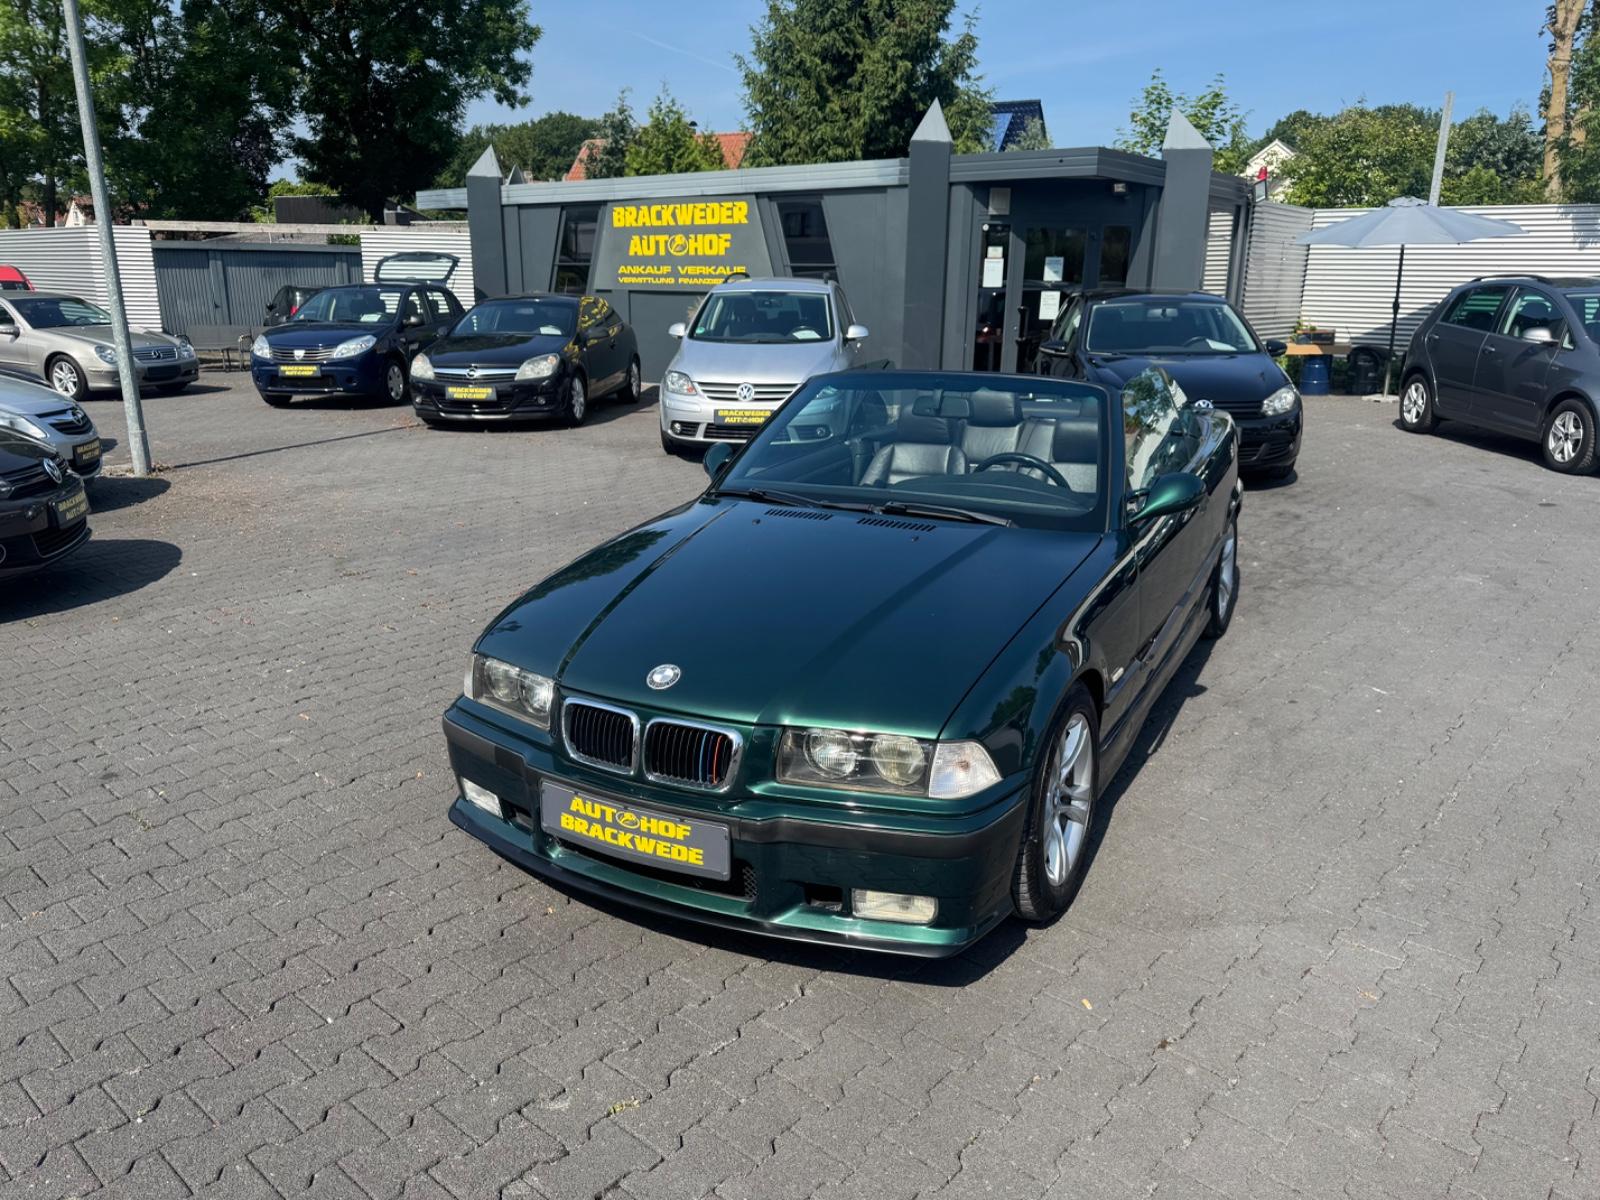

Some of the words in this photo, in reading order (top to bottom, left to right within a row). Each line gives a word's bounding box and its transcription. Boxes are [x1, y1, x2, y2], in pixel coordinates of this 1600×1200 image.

[612, 201, 749, 228] BRACKWEDER
[618, 265, 672, 275] ANKAUF
[677, 265, 747, 275] VERKAUF
[618, 276, 675, 284] VERMITTLUNG
[560, 812, 704, 866] BRACKWEDE
